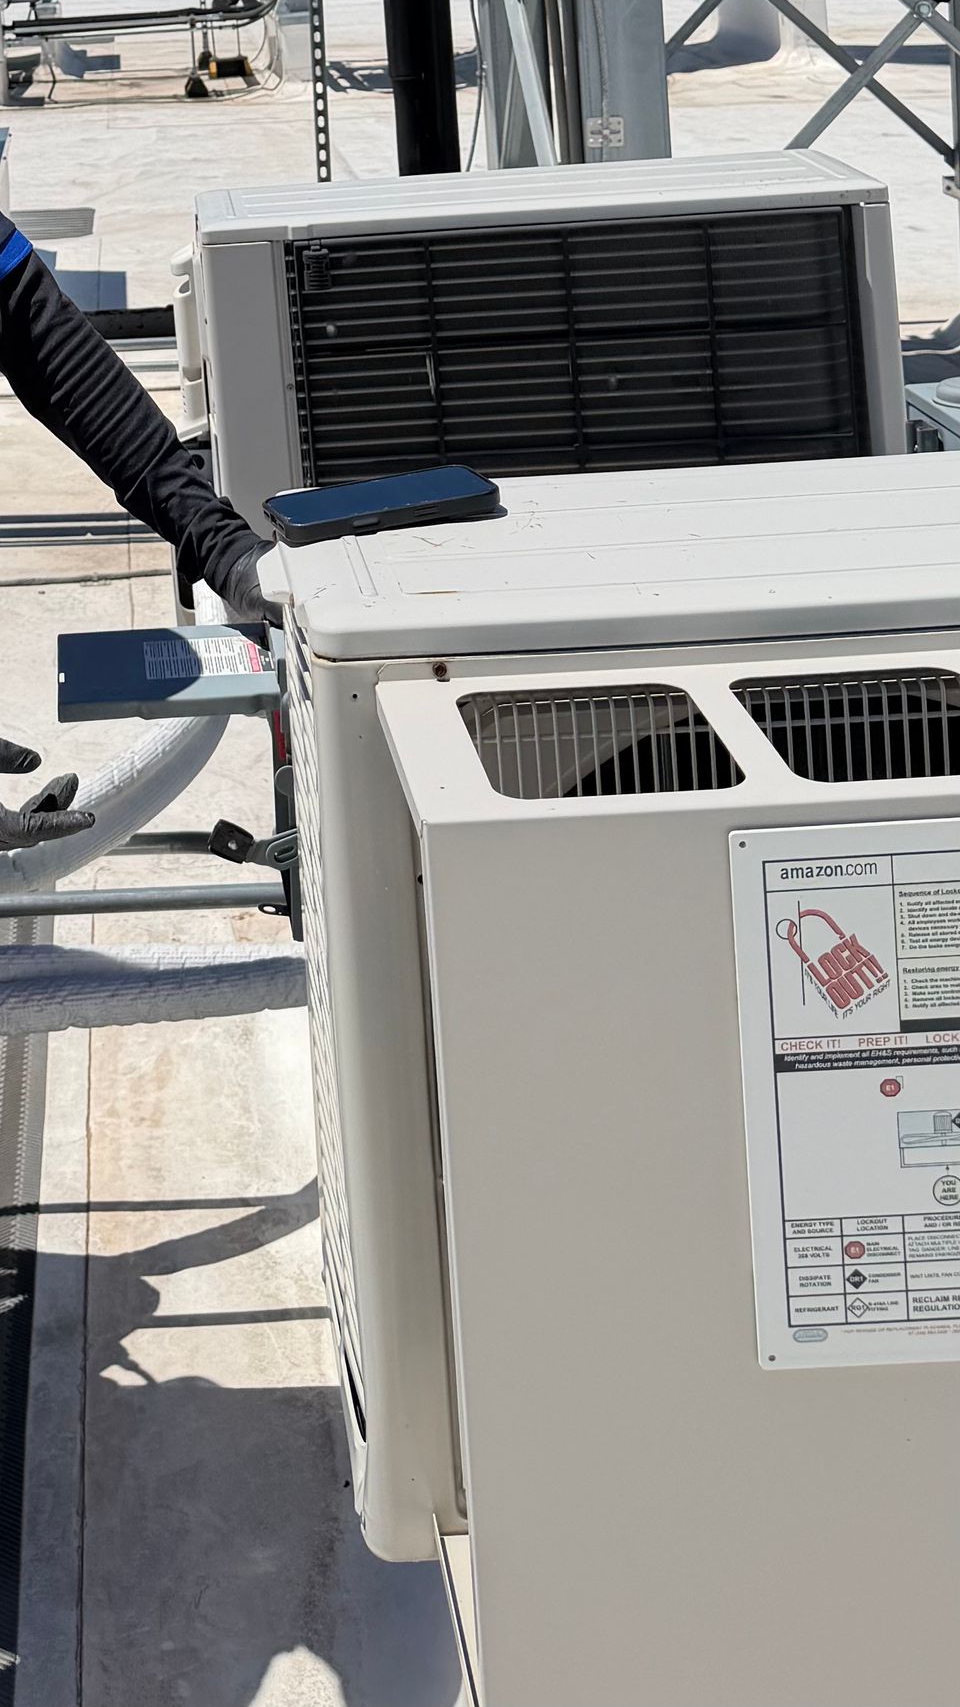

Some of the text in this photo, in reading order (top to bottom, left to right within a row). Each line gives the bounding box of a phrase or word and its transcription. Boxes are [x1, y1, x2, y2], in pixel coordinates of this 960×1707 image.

[780, 862, 878, 880] amazon.com
[806, 933, 871, 987] LOCK
[825, 954, 889, 1009] OUT!!
[854, 993, 872, 1011] YOUR
[872, 979, 891, 999] RIGHT
[780, 1032, 960, 1052] CHECK IT! PREP IT! LOCK
[784, 1052, 809, 1062] Identify
[810, 1052, 823, 1060] and
[824, 1050, 860, 1060] implement
[861, 1050, 870, 1058] all
[870, 1049, 893, 1058] EH&S
[941, 1046, 958, 1054] such
[795, 1060, 831, 1070] hazardous
[832, 1060, 853, 1068] waste
[853, 1057, 901, 1067] management,
[901, 1055, 932, 1064] personal
[856, 1218, 887, 1226] LOCKOUT
[912, 1295, 950, 1304] RECLAIM
